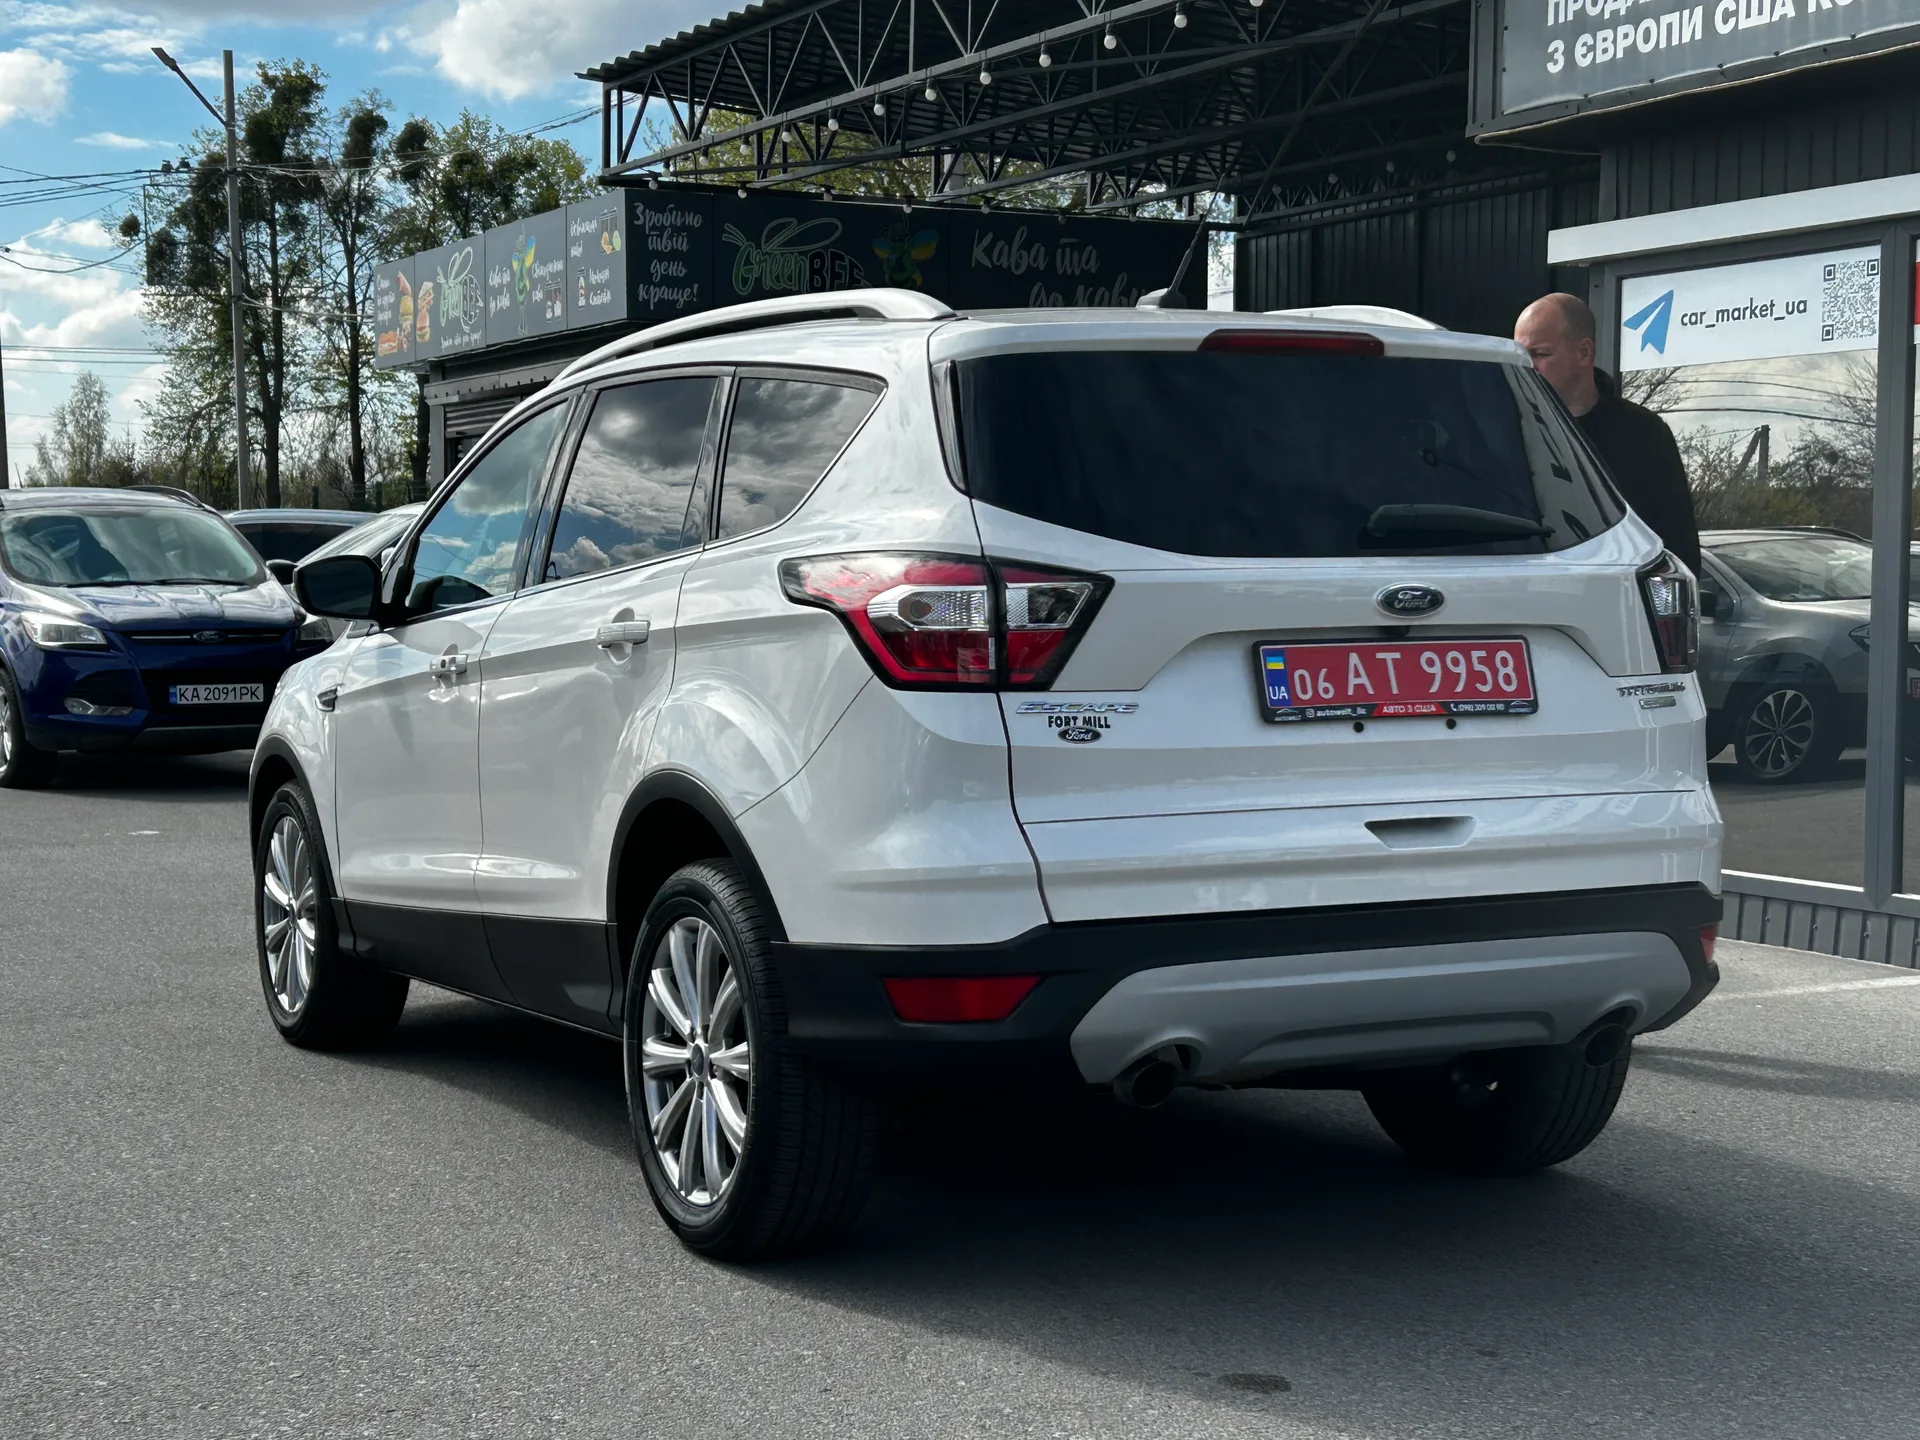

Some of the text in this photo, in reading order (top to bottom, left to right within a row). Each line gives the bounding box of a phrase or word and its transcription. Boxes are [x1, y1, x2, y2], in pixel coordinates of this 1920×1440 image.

[1546, 0, 1796, 73] З ЄВРОПИ США
[633, 203, 703, 235] Зробимо
[648, 228, 689, 252] твій
[971, 225, 1100, 276] Кава та
[650, 259, 688, 283] день
[637, 284, 699, 311] краще!
[1680, 297, 1808, 329] car_market_ua
[1394, 590, 1431, 609] Ford
[1294, 650, 1518, 700] 06 AT 9958
[1269, 686, 1288, 700] UA
[1016, 700, 1140, 714] ESCAPE
[1047, 715, 1111, 729] FORT MILL
[1065, 729, 1094, 740] Ford
